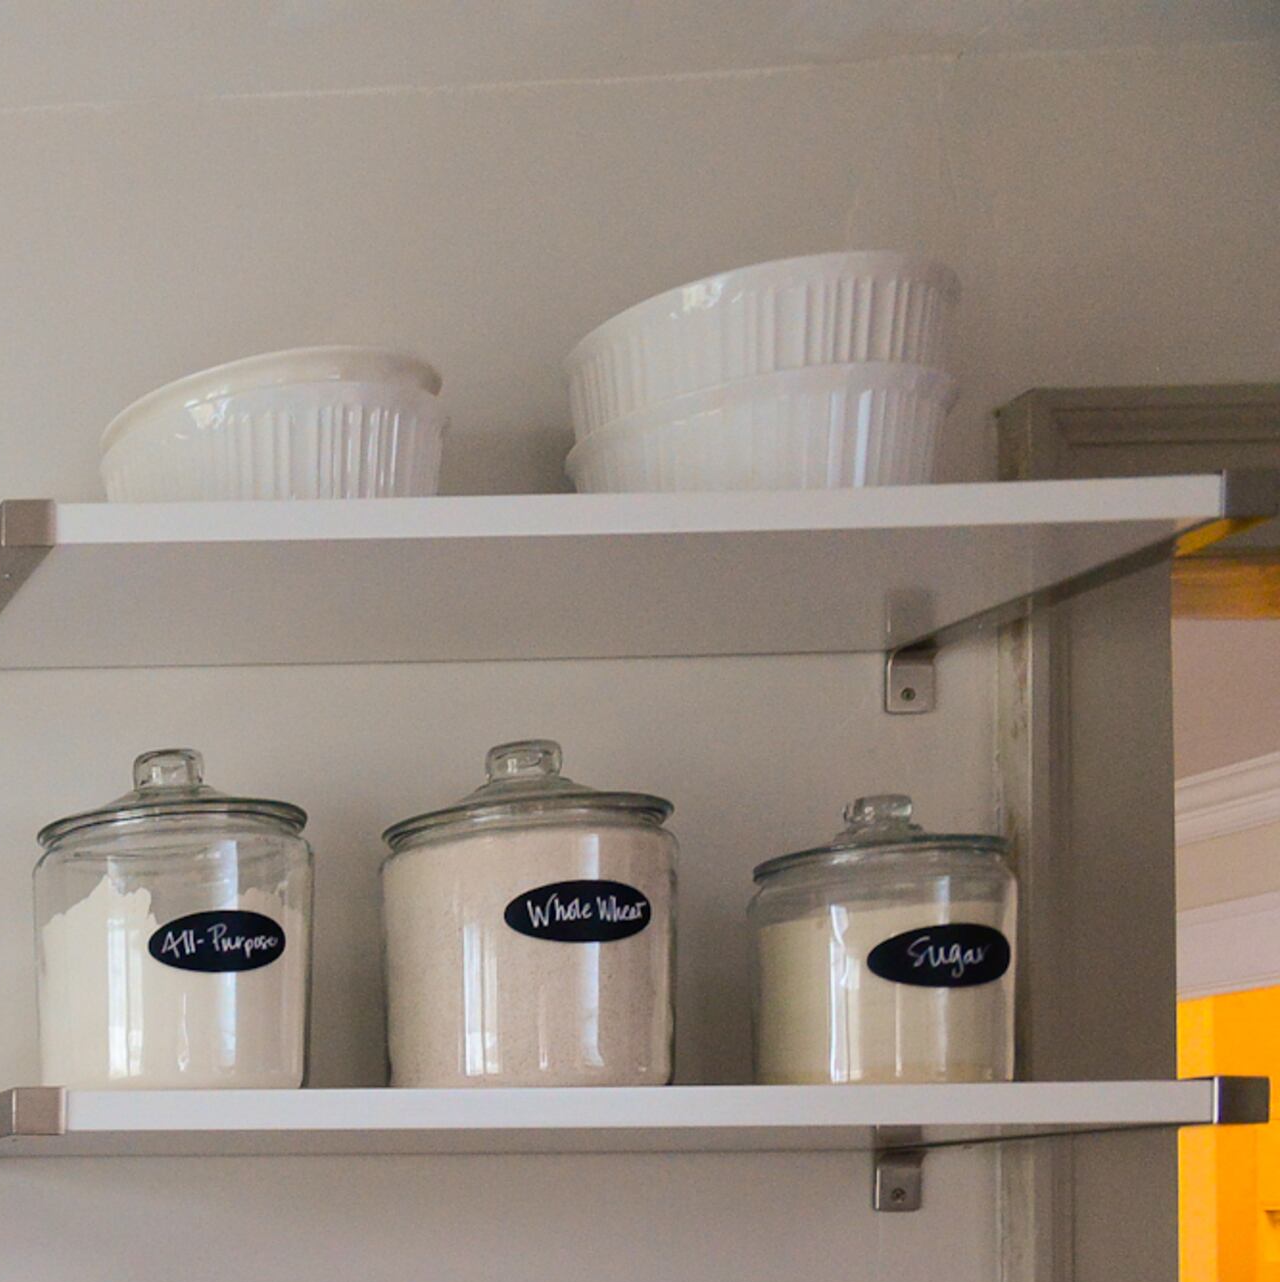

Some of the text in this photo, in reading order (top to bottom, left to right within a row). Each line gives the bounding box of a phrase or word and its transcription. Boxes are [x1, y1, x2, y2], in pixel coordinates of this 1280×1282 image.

[526, 893, 647, 928] Whole Wheat
[906, 936, 992, 979] Sugar
